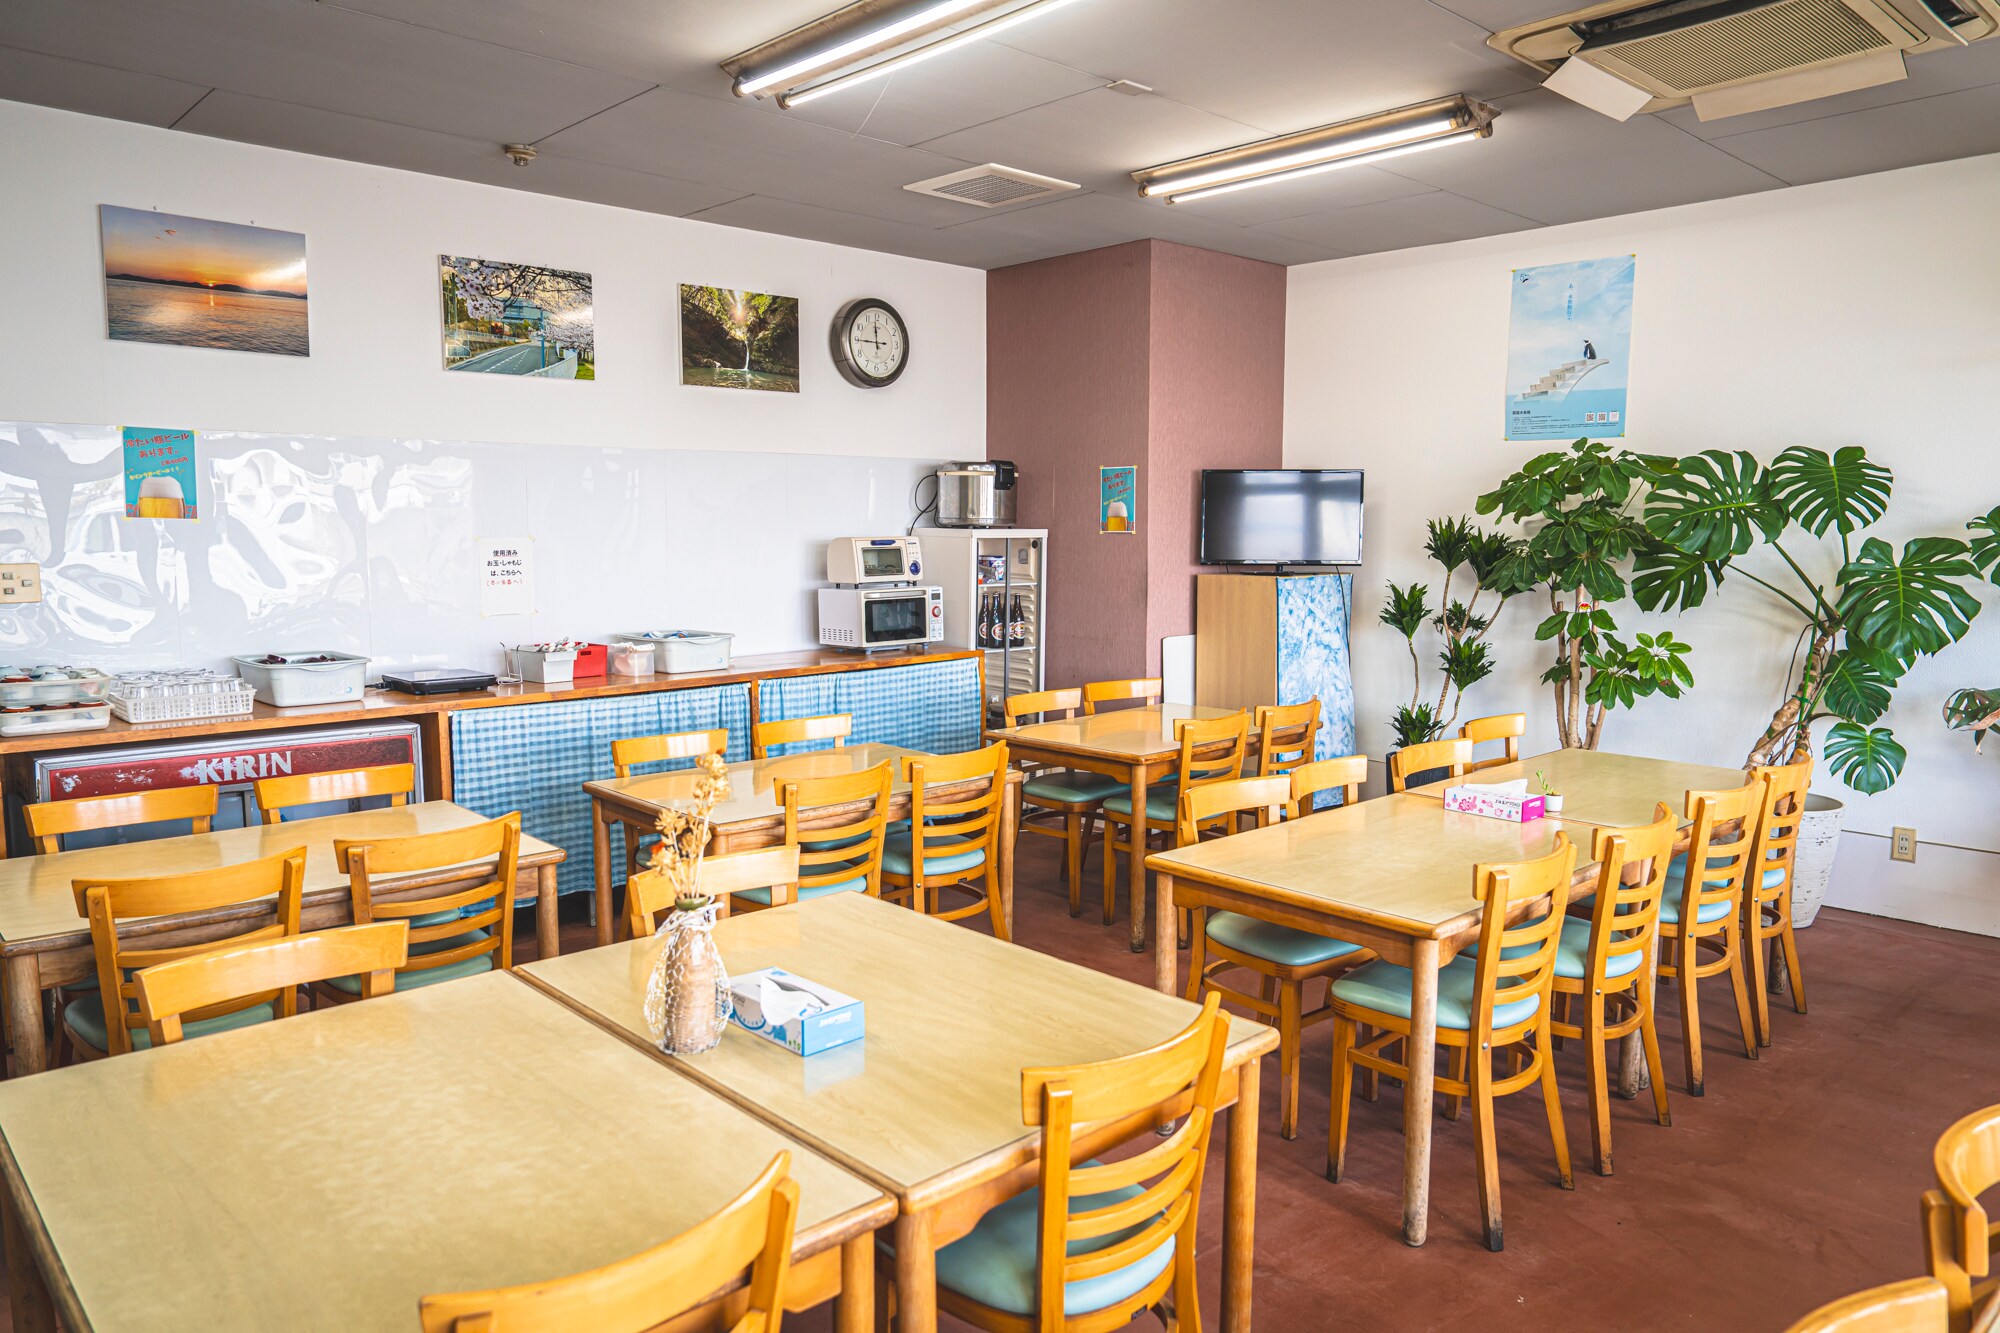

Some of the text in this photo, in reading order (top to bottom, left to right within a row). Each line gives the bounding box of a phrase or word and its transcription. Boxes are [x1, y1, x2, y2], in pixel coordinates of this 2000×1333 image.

[865, 315, 871, 323] 11
[874, 313, 880, 322] 12
[885, 318, 888, 326] 1
[857, 323, 864, 332] 10
[892, 328, 897, 337] 2
[894, 341, 899, 350] 3
[857, 350, 863, 358] 8
[890, 354, 895, 362] 4
[865, 360, 870, 368] 7
[884, 362, 889, 370] 5
[874, 364, 879, 373] 6
[198, 750, 293, 784] KIRIN
